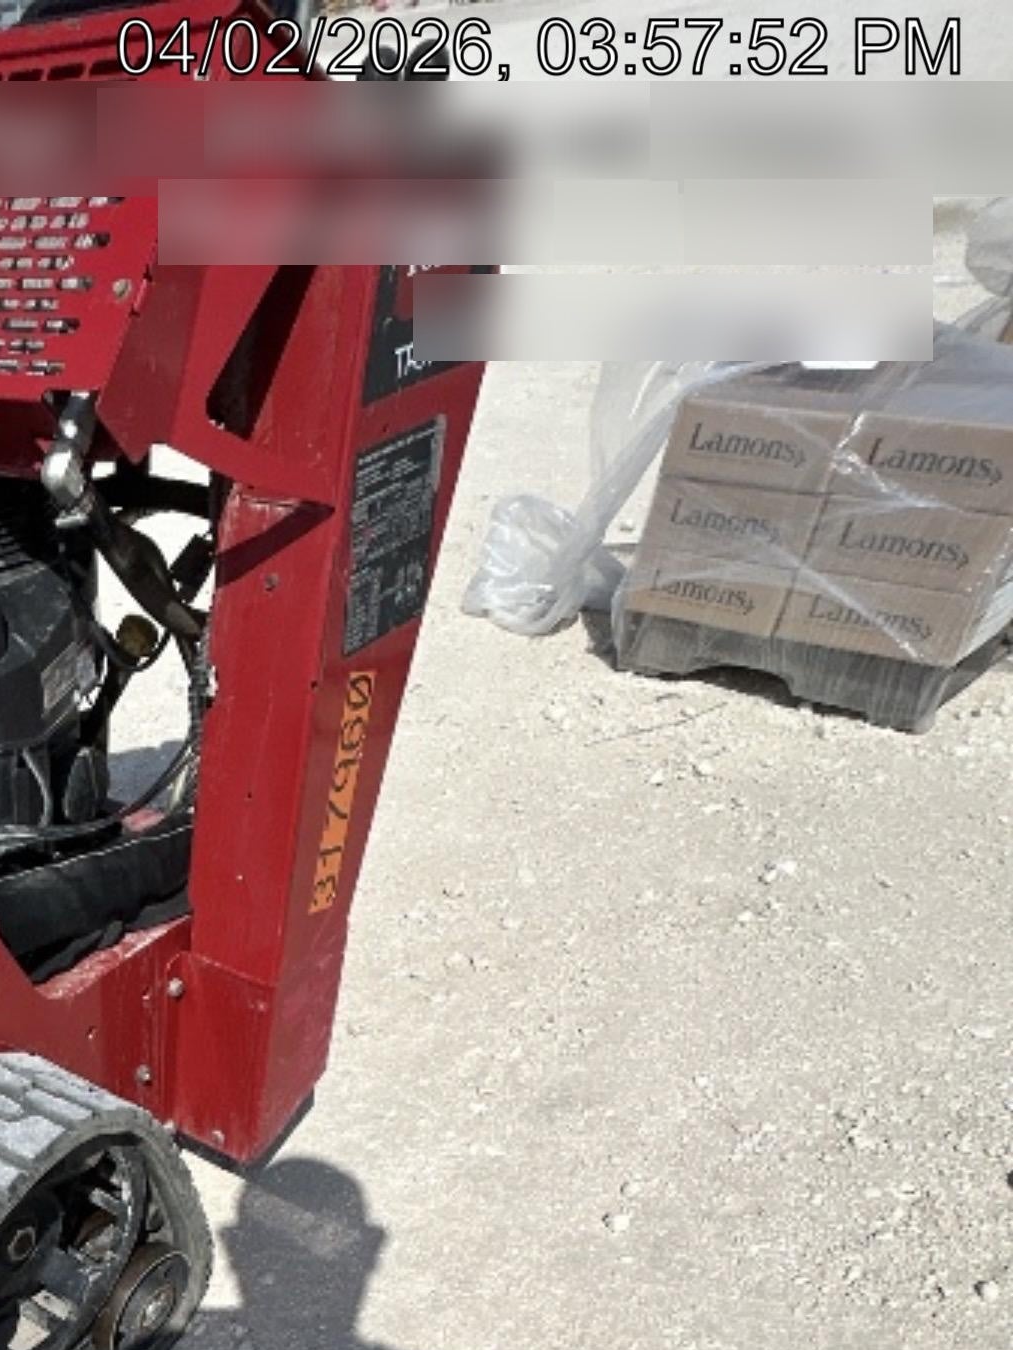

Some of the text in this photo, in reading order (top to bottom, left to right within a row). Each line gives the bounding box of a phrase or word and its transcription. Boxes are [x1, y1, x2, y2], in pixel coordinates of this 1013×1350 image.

[689, 421, 796, 463] Lamons
[868, 436, 992, 482] Lamons
[670, 498, 771, 539] Lamons
[838, 520, 960, 565] Lamons
[650, 568, 748, 609] Lamons
[808, 594, 924, 637] Lamons
